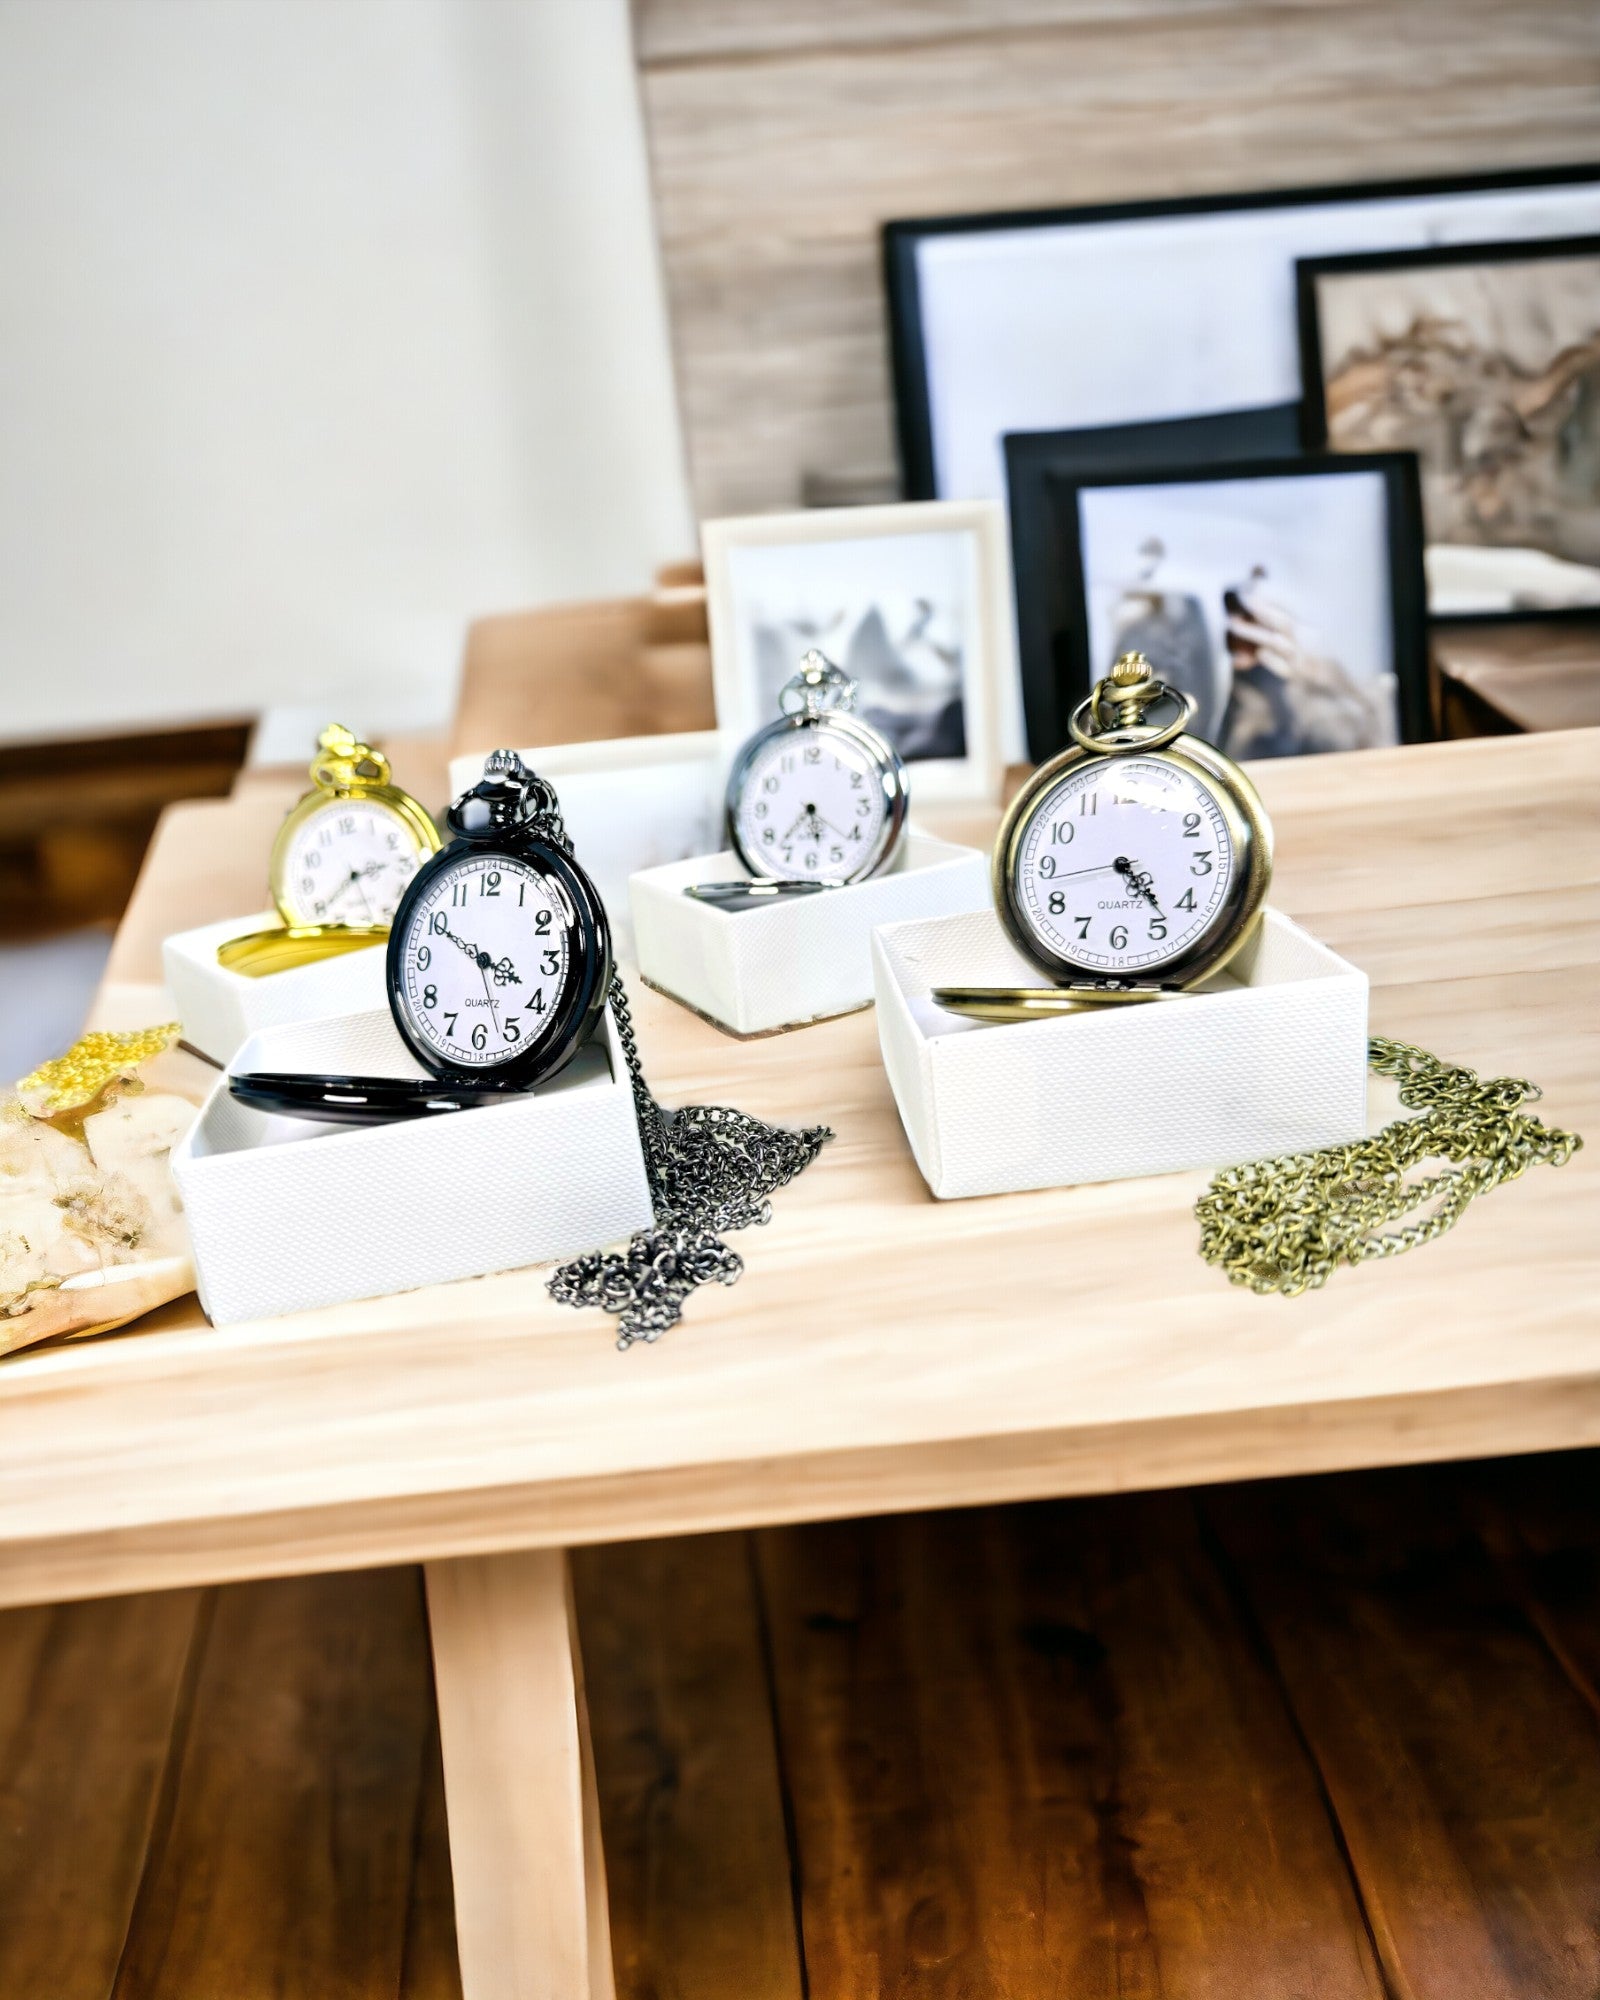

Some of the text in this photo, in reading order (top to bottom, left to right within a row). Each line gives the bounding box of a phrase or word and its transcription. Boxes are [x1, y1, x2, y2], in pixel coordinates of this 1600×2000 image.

[804, 747, 820, 764] 12
[764, 777, 778, 794] 10
[851, 772, 862, 789] 2
[1071, 778, 1085, 792] 23
[756, 802, 767, 818] 9
[856, 798, 870, 816] 3
[1080, 792, 1097, 815] 11
[338, 817, 355, 835] 12
[1037, 814, 1050, 828] 22
[1182, 813, 1201, 838] 2
[387, 833, 399, 850] 2
[763, 828, 774, 845] 8
[848, 825, 861, 842] 4
[1051, 822, 1074, 844] 10
[305, 852, 321, 869] 10
[781, 846, 792, 863] 7
[805, 852, 817, 870] 6
[830, 846, 843, 862] 5
[485, 861, 497, 870] 24
[1024, 862, 1034, 874] 21
[1039, 856, 1056, 879] 9
[1190, 851, 1212, 875] 3
[1219, 856, 1227, 870] 15
[302, 877, 314, 894] 9
[448, 871, 459, 884] 23
[480, 872, 501, 896] 12
[452, 884, 466, 907] 11
[519, 882, 525, 907] 1
[1048, 891, 1066, 914] 8
[1173, 887, 1197, 912] 4
[420, 906, 430, 918] 22
[1098, 900, 1142, 910] QUARTZ
[1201, 905, 1213, 919] 16
[535, 910, 552, 935] 2
[1032, 908, 1044, 921] 20
[428, 911, 448, 936] 10
[1074, 917, 1092, 939] 7
[1148, 918, 1167, 940] 5
[1110, 925, 1128, 949] 6
[1065, 941, 1077, 954] 19
[1162, 942, 1174, 955] 17
[408, 954, 416, 964] 21
[417, 946, 431, 971] 9
[540, 950, 560, 976] 3
[1112, 957, 1124, 967] 18
[424, 984, 437, 1009] 8
[465, 999, 500, 1009] QUARTZ
[525, 988, 546, 1014] 4
[412, 1000, 422, 1012] 20
[444, 1012, 458, 1037] 7
[503, 1017, 520, 1042] 5
[436, 1035, 447, 1048] 19
[472, 1024, 488, 1050] 6
[474, 1052, 485, 1061] 18
